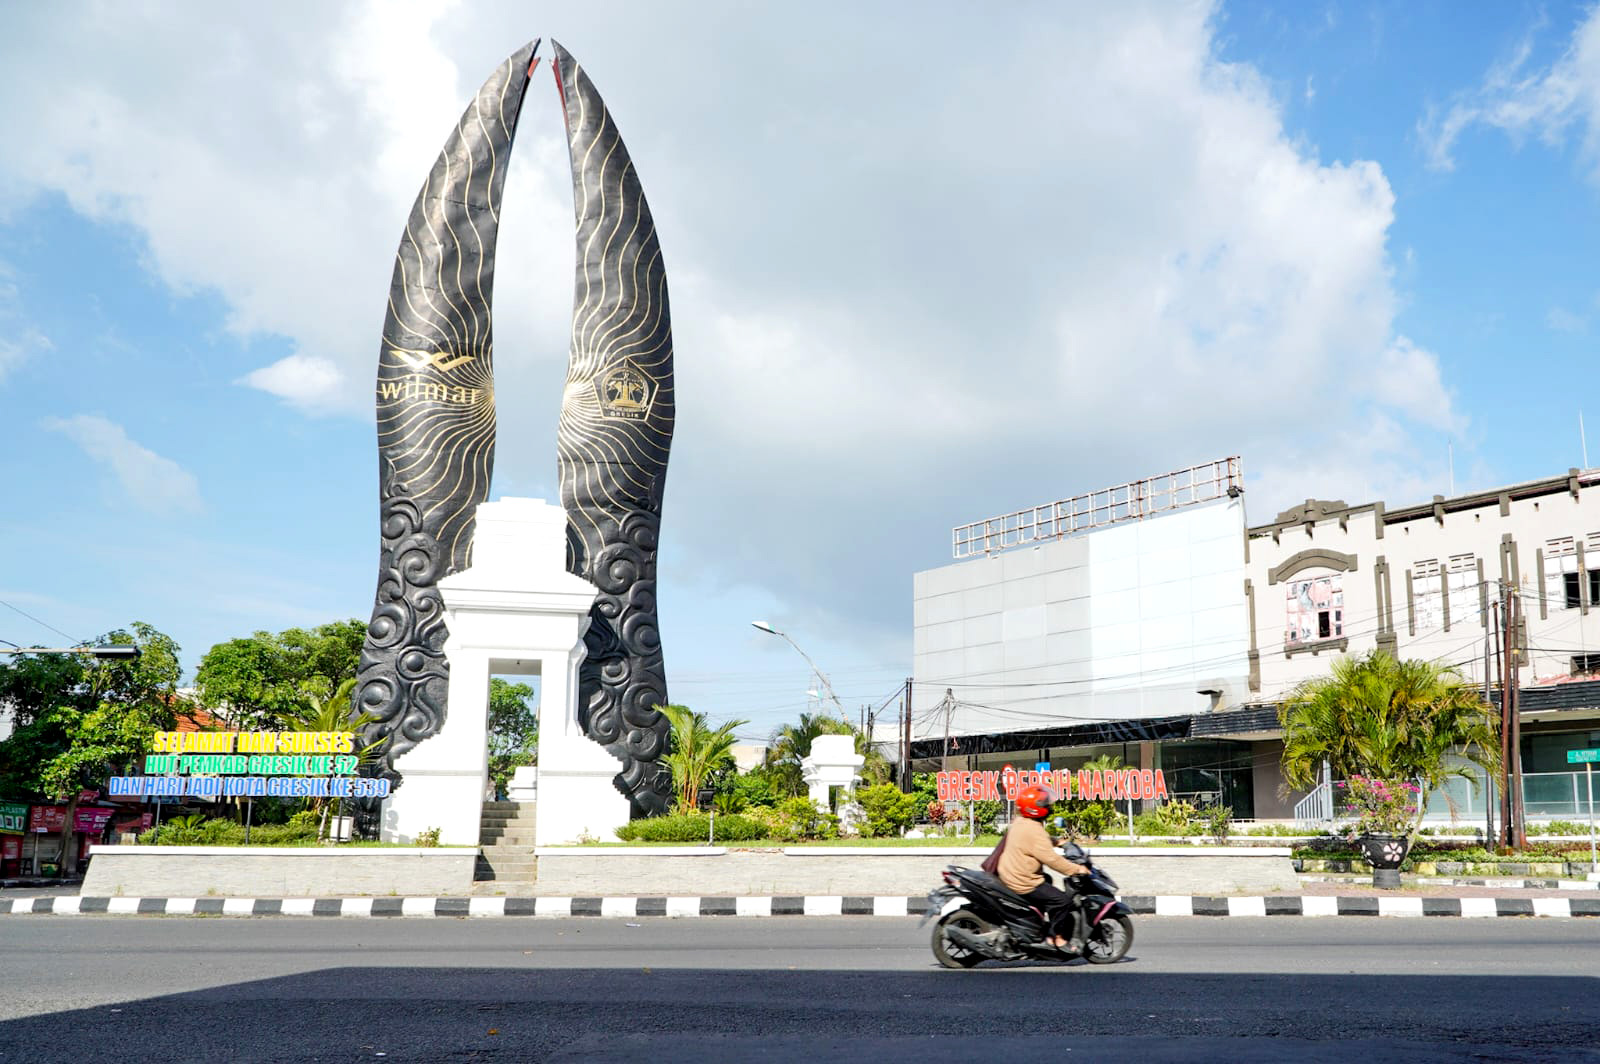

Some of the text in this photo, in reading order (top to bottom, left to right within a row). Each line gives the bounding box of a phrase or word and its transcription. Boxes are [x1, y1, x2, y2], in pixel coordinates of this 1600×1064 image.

[381, 374, 481, 404] wilmar
[153, 731, 355, 753] SELAMAT DAN SUKSES
[144, 755, 359, 775] HUT PEMKAB GRESIK KE 52
[110, 777, 390, 798] DAN HARI JADI KOTA GRESIK KE 539
[937, 771, 1000, 801] GRESIK
[1078, 769, 1168, 801] NARKOBA
